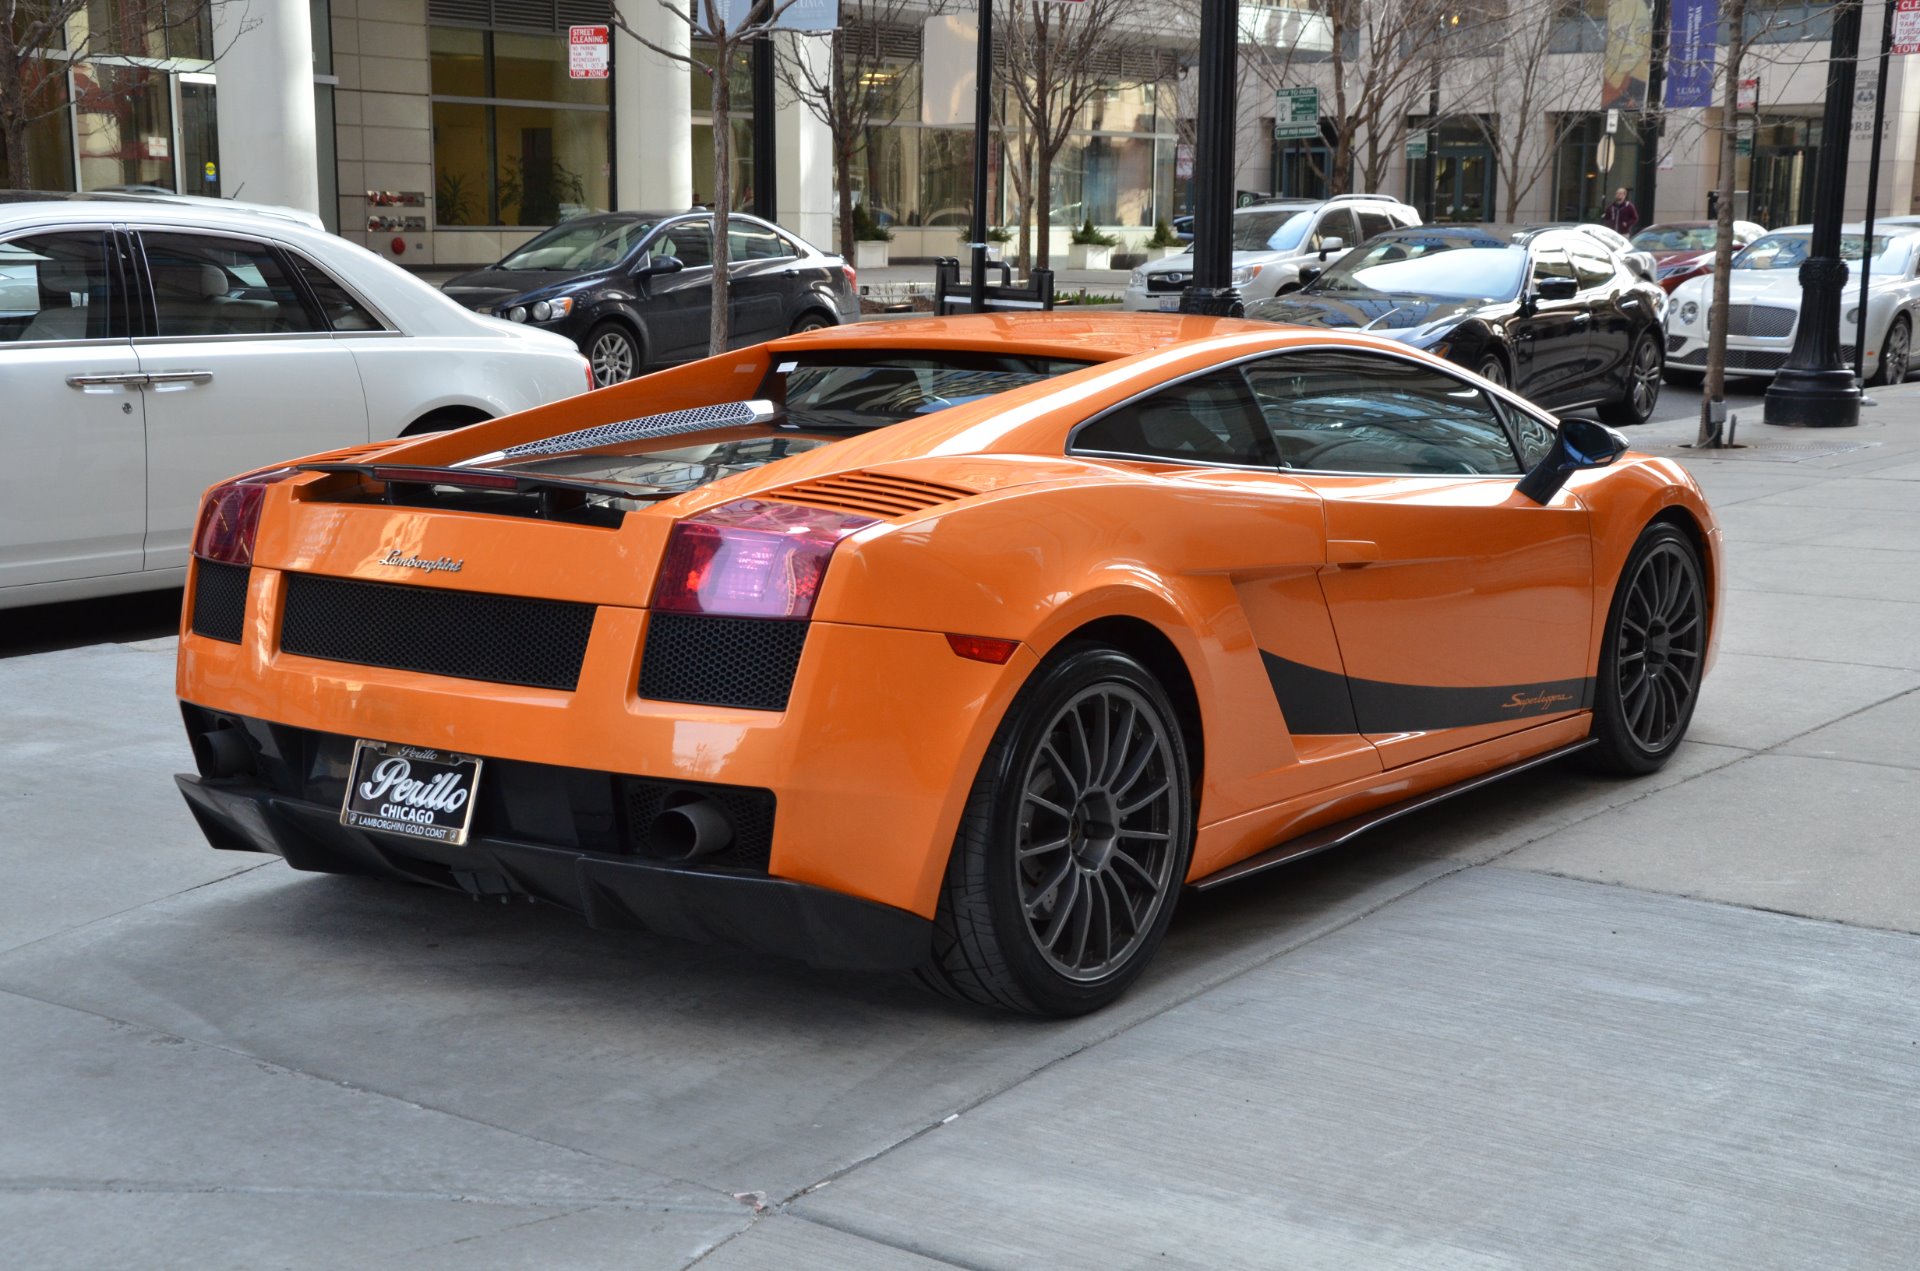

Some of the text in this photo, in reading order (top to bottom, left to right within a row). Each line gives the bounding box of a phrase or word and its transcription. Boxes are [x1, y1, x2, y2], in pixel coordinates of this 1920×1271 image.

[1901, 0, 1920, 10] CLE
[1896, 44, 1919, 53] TOW
[379, 549, 463, 573] Lamborghini
[398, 746, 438, 760] Perillo
[359, 757, 468, 814] Perillo
[380, 804, 434, 824] CHICAGO
[358, 816, 447, 839] LAMBORGHINI GOLD COAST
